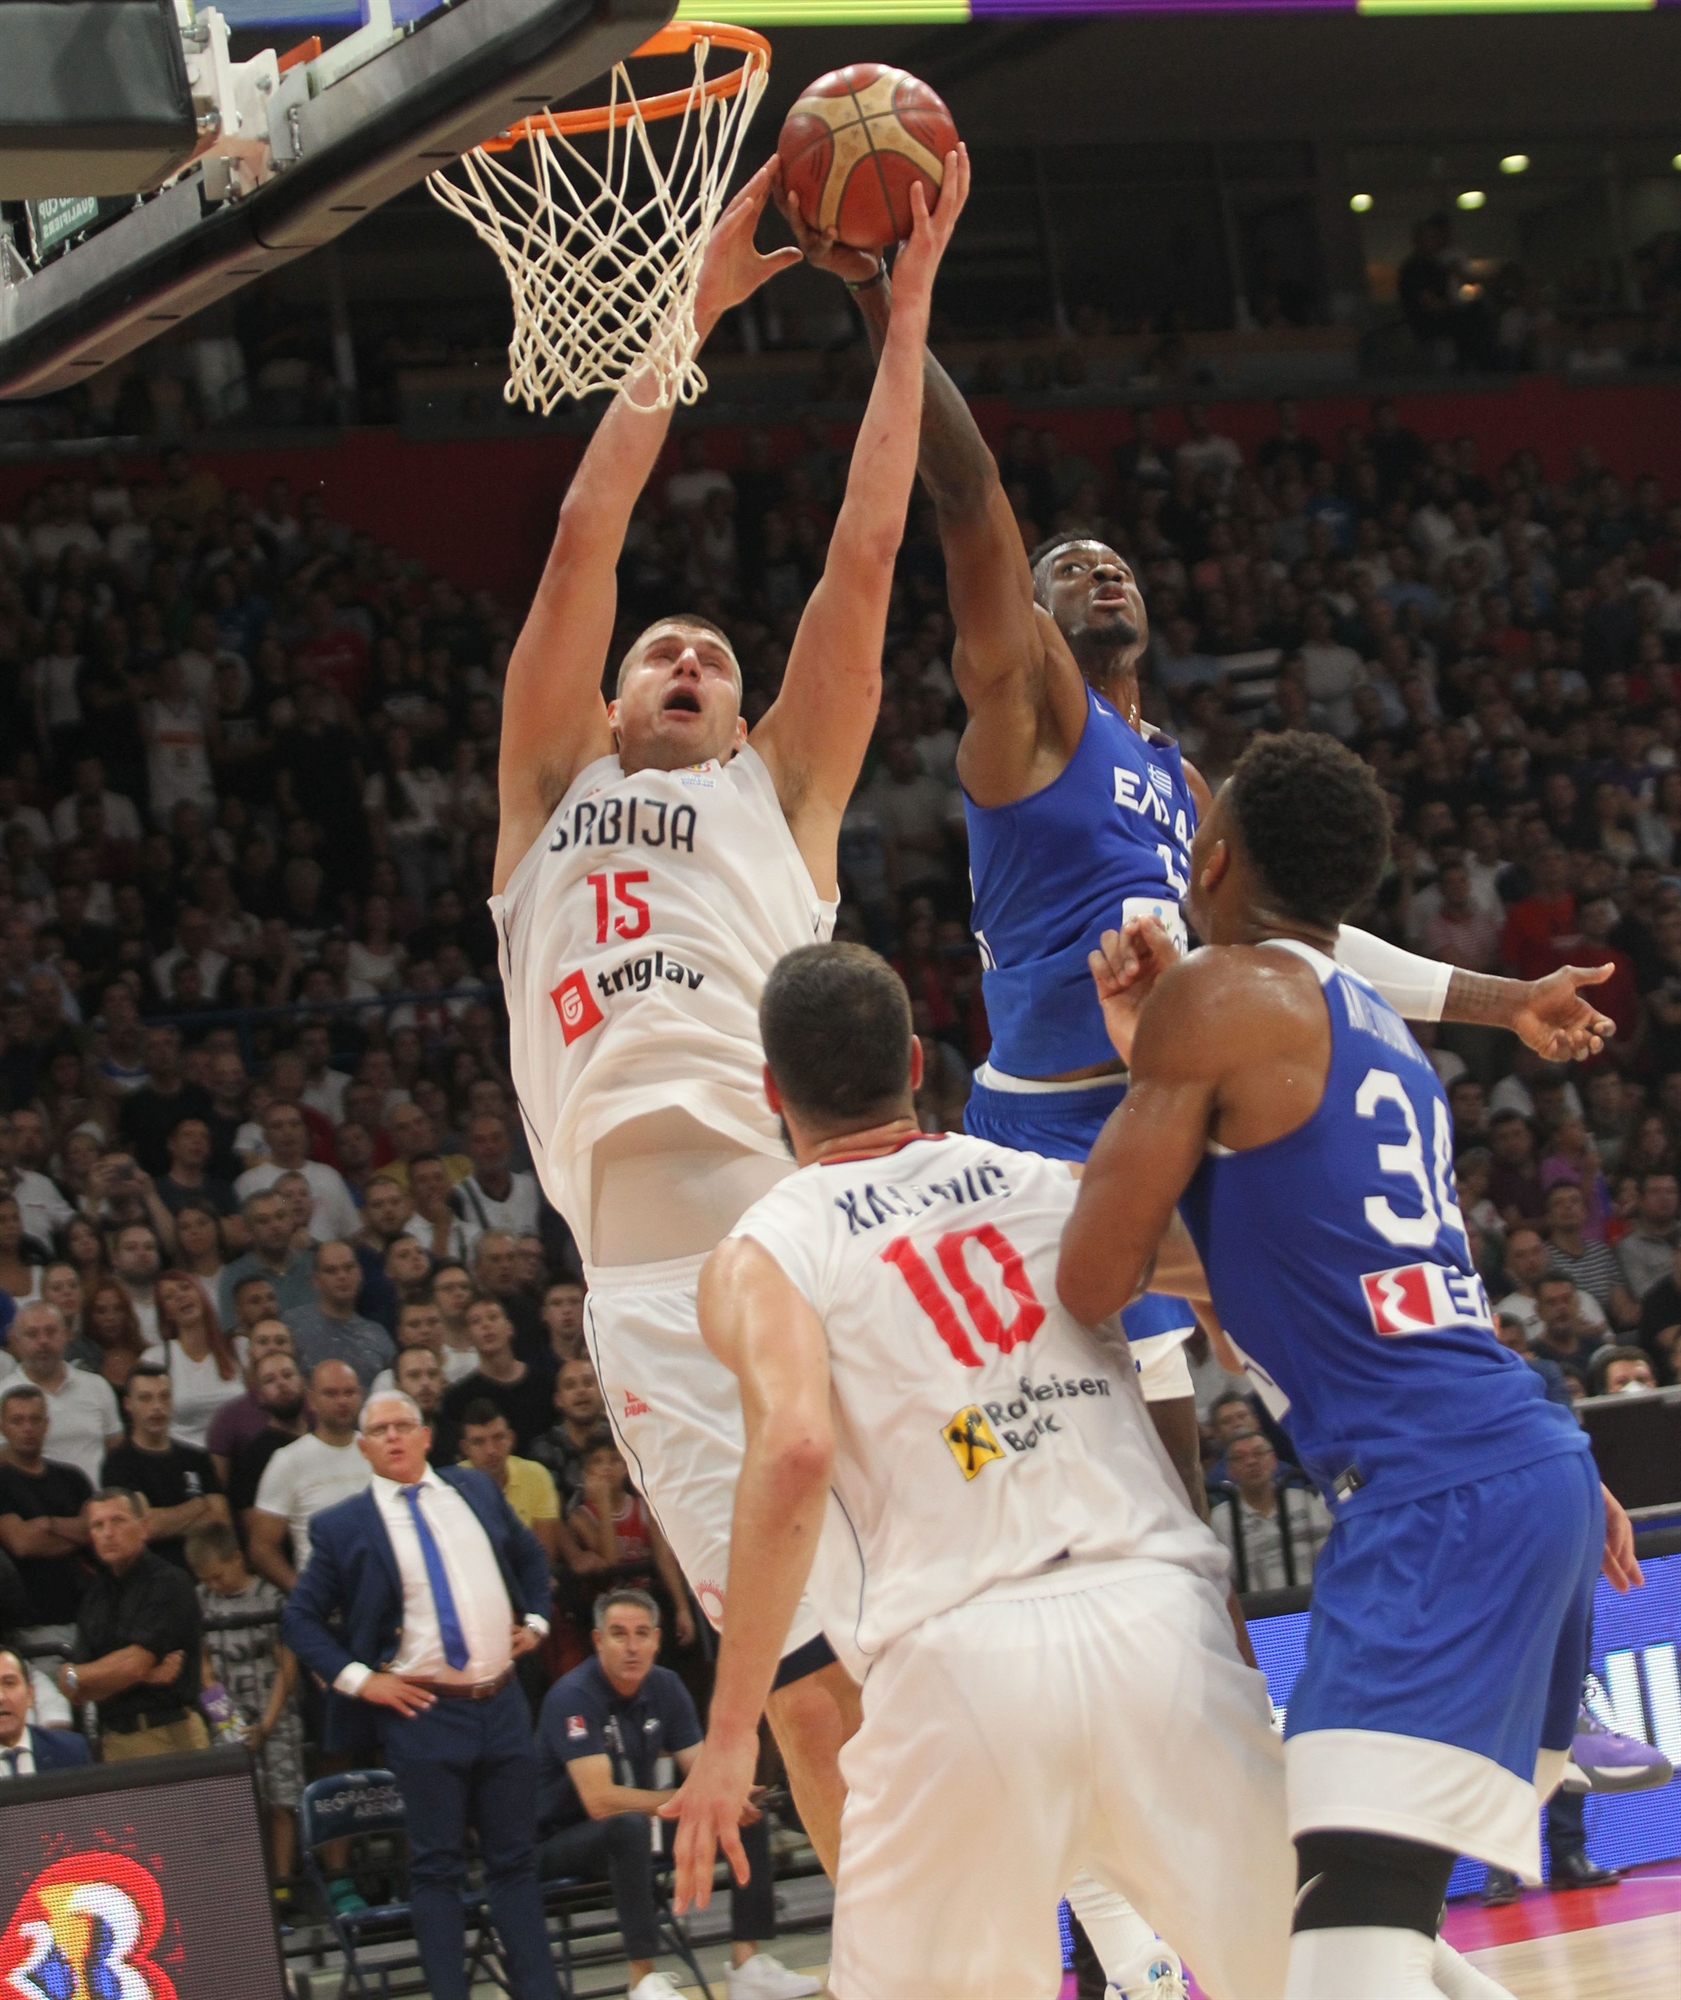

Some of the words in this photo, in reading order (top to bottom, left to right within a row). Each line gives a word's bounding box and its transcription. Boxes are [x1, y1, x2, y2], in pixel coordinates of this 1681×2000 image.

[550, 796, 698, 853] SRBIJA
[586, 869, 652, 945] 15
[596, 950, 706, 998] triglav
[878, 1221, 1047, 1369] 10
